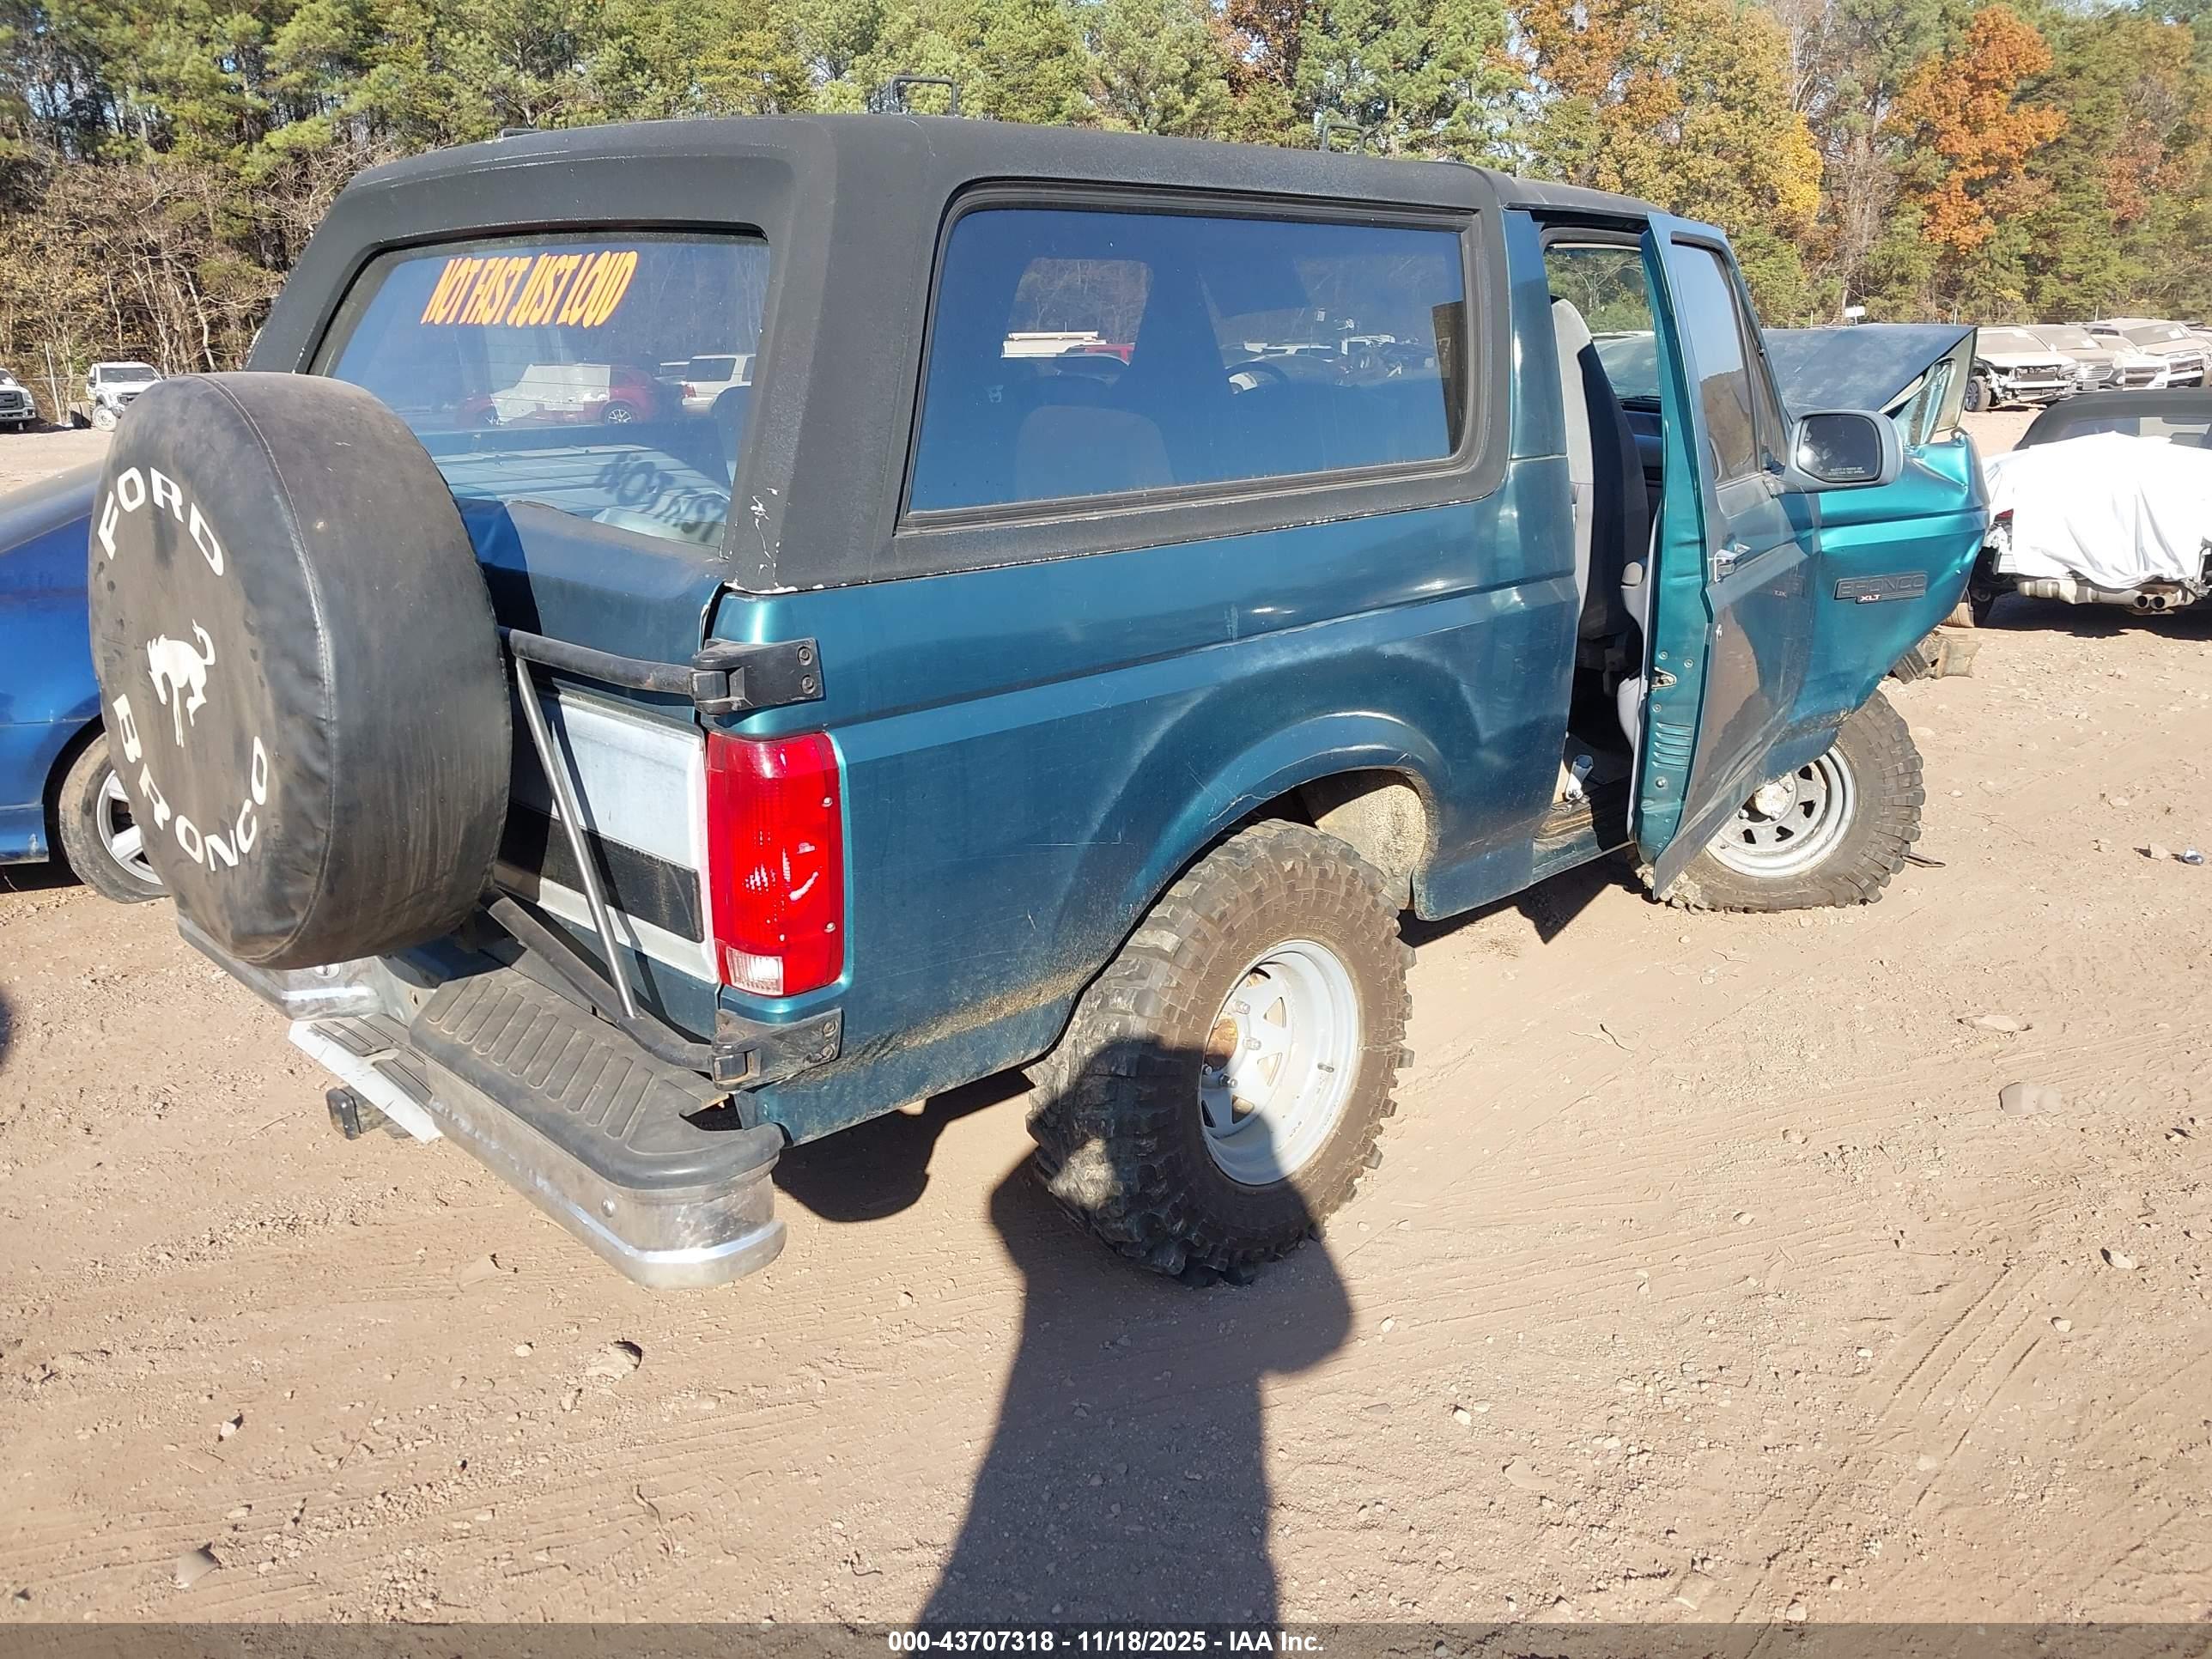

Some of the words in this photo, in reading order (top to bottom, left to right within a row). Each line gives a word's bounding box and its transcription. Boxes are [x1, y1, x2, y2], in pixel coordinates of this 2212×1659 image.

[420, 257, 483, 325] NOT
[458, 257, 532, 325] FAST
[507, 252, 583, 328] JUST
[556, 250, 638, 329] LOUD
[98, 466, 224, 576] FORD
[1840, 574, 1927, 596] BRONCO
[112, 693, 268, 872] BRONCO
